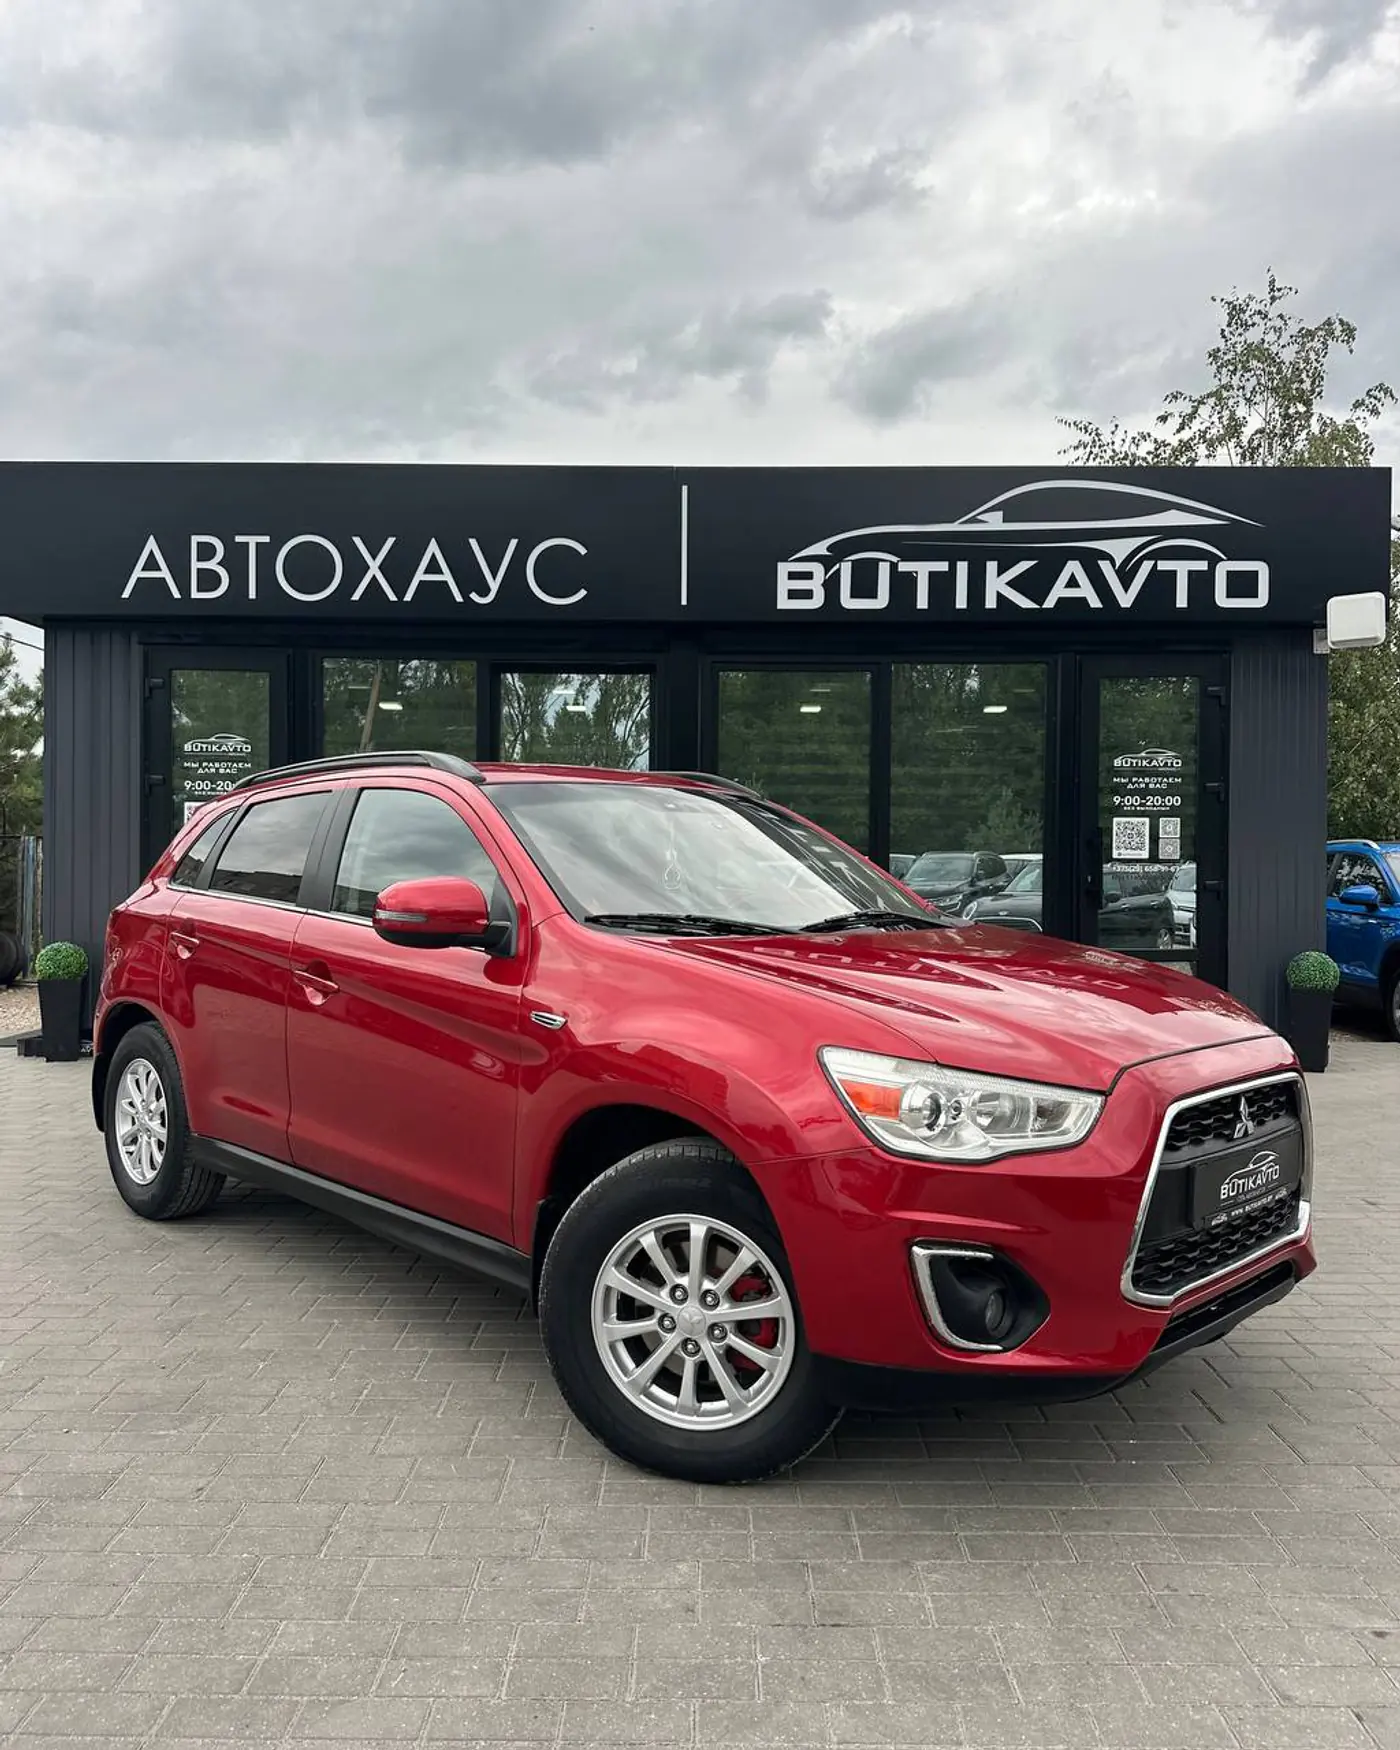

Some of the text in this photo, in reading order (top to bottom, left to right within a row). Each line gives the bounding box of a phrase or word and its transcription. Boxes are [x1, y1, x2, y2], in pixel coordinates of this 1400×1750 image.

[121, 534, 588, 606] АВТОХАУС
[776, 559, 1270, 611] BUTIKAVTO
[184, 743, 252, 752] BUTIKAVTO
[1113, 758, 1182, 767] BUTIKAVTO
[1113, 795, 1182, 807] 9:00-20:00
[1220, 1165, 1280, 1200] BUTIKAVTO
